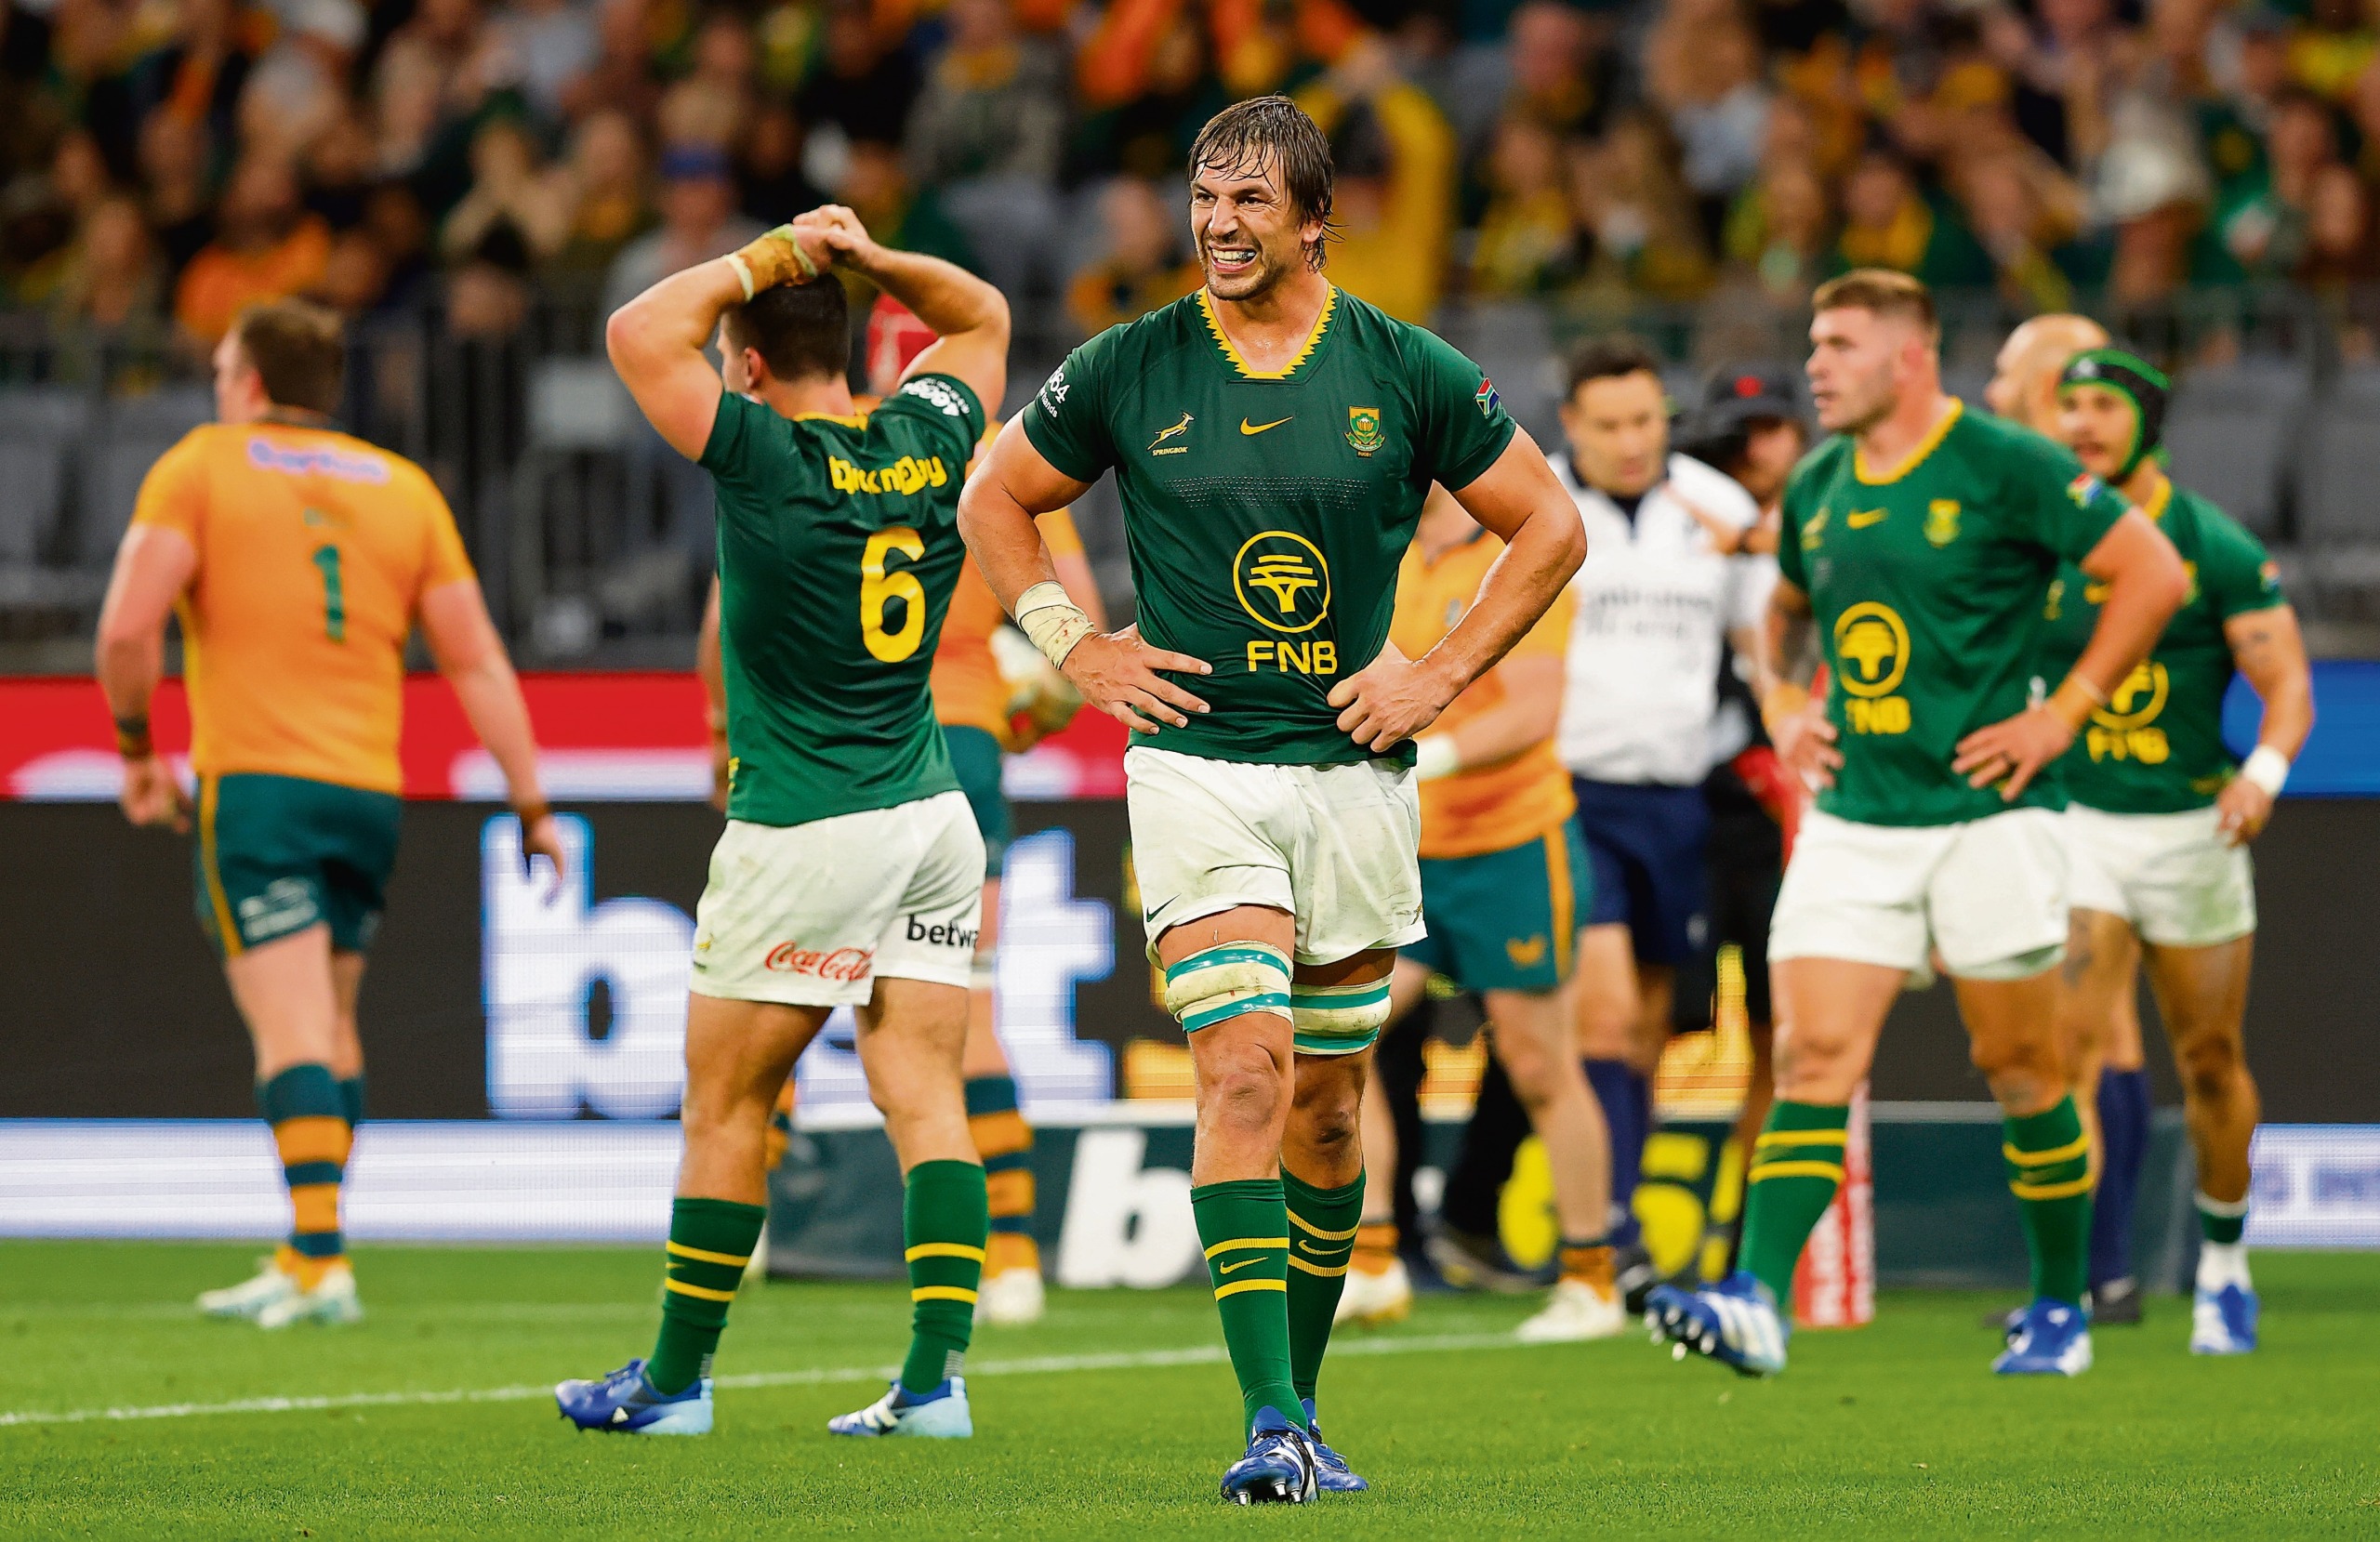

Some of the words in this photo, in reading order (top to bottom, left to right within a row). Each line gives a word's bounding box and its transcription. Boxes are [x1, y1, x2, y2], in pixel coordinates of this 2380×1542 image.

[1152, 446, 1189, 456] SPRINGBOK
[312, 544, 346, 644] 1
[860, 526, 926, 664] 6
[1247, 640, 1338, 675] FNB
